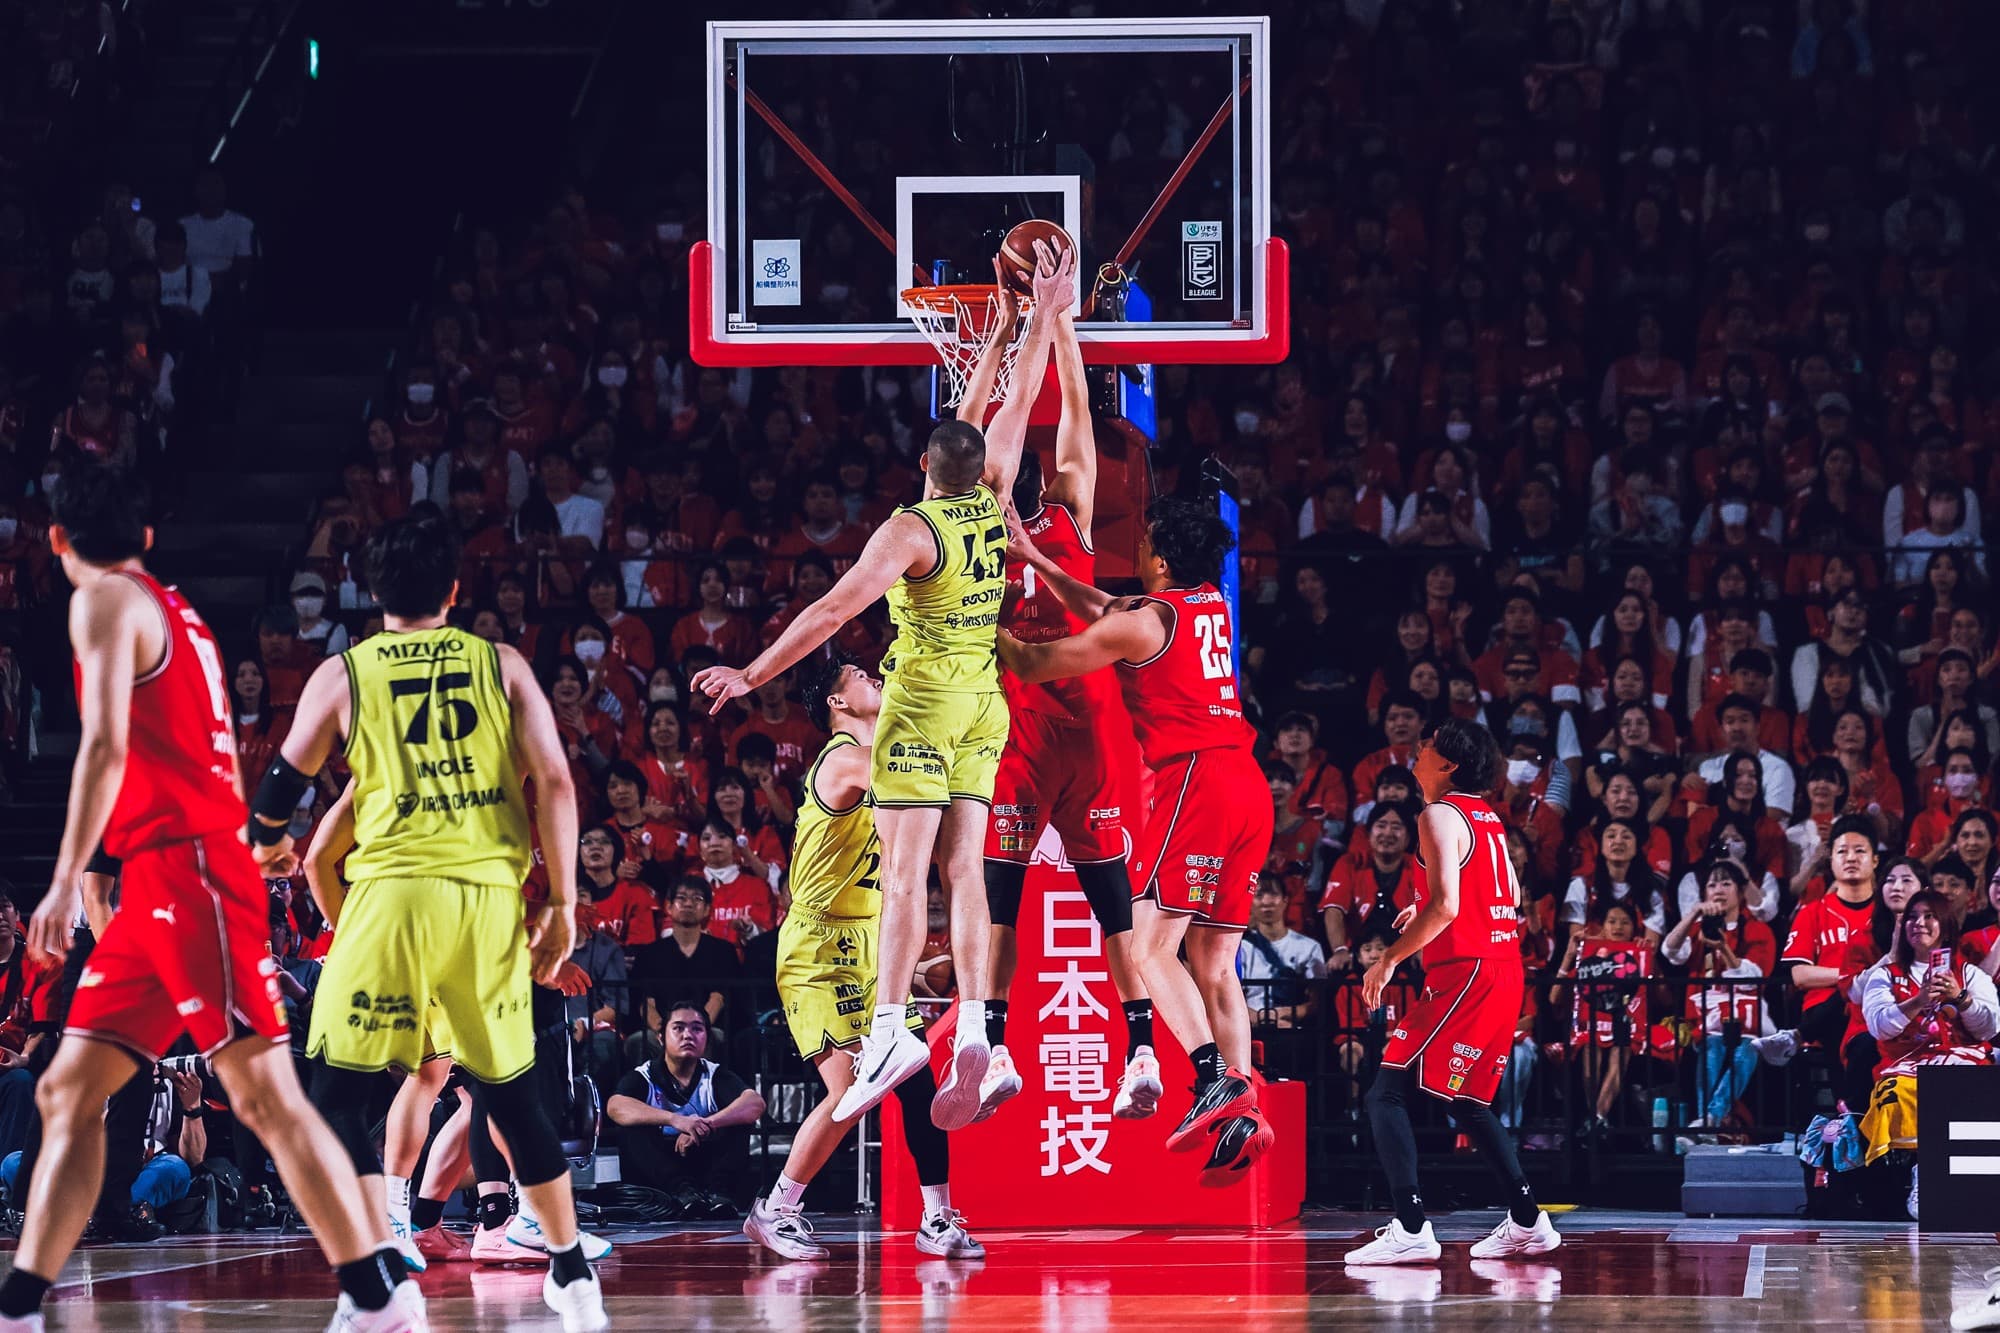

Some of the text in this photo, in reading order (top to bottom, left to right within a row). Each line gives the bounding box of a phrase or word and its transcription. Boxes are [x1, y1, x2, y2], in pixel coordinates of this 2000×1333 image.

[961, 525, 1006, 582] 45
[1194, 614, 1233, 680] 25
[389, 672, 479, 745] 75
[900, 761, 943, 776] 山一地所
[1200, 872, 1220, 885] JA
[1038, 891, 1113, 1177] 日本電技
